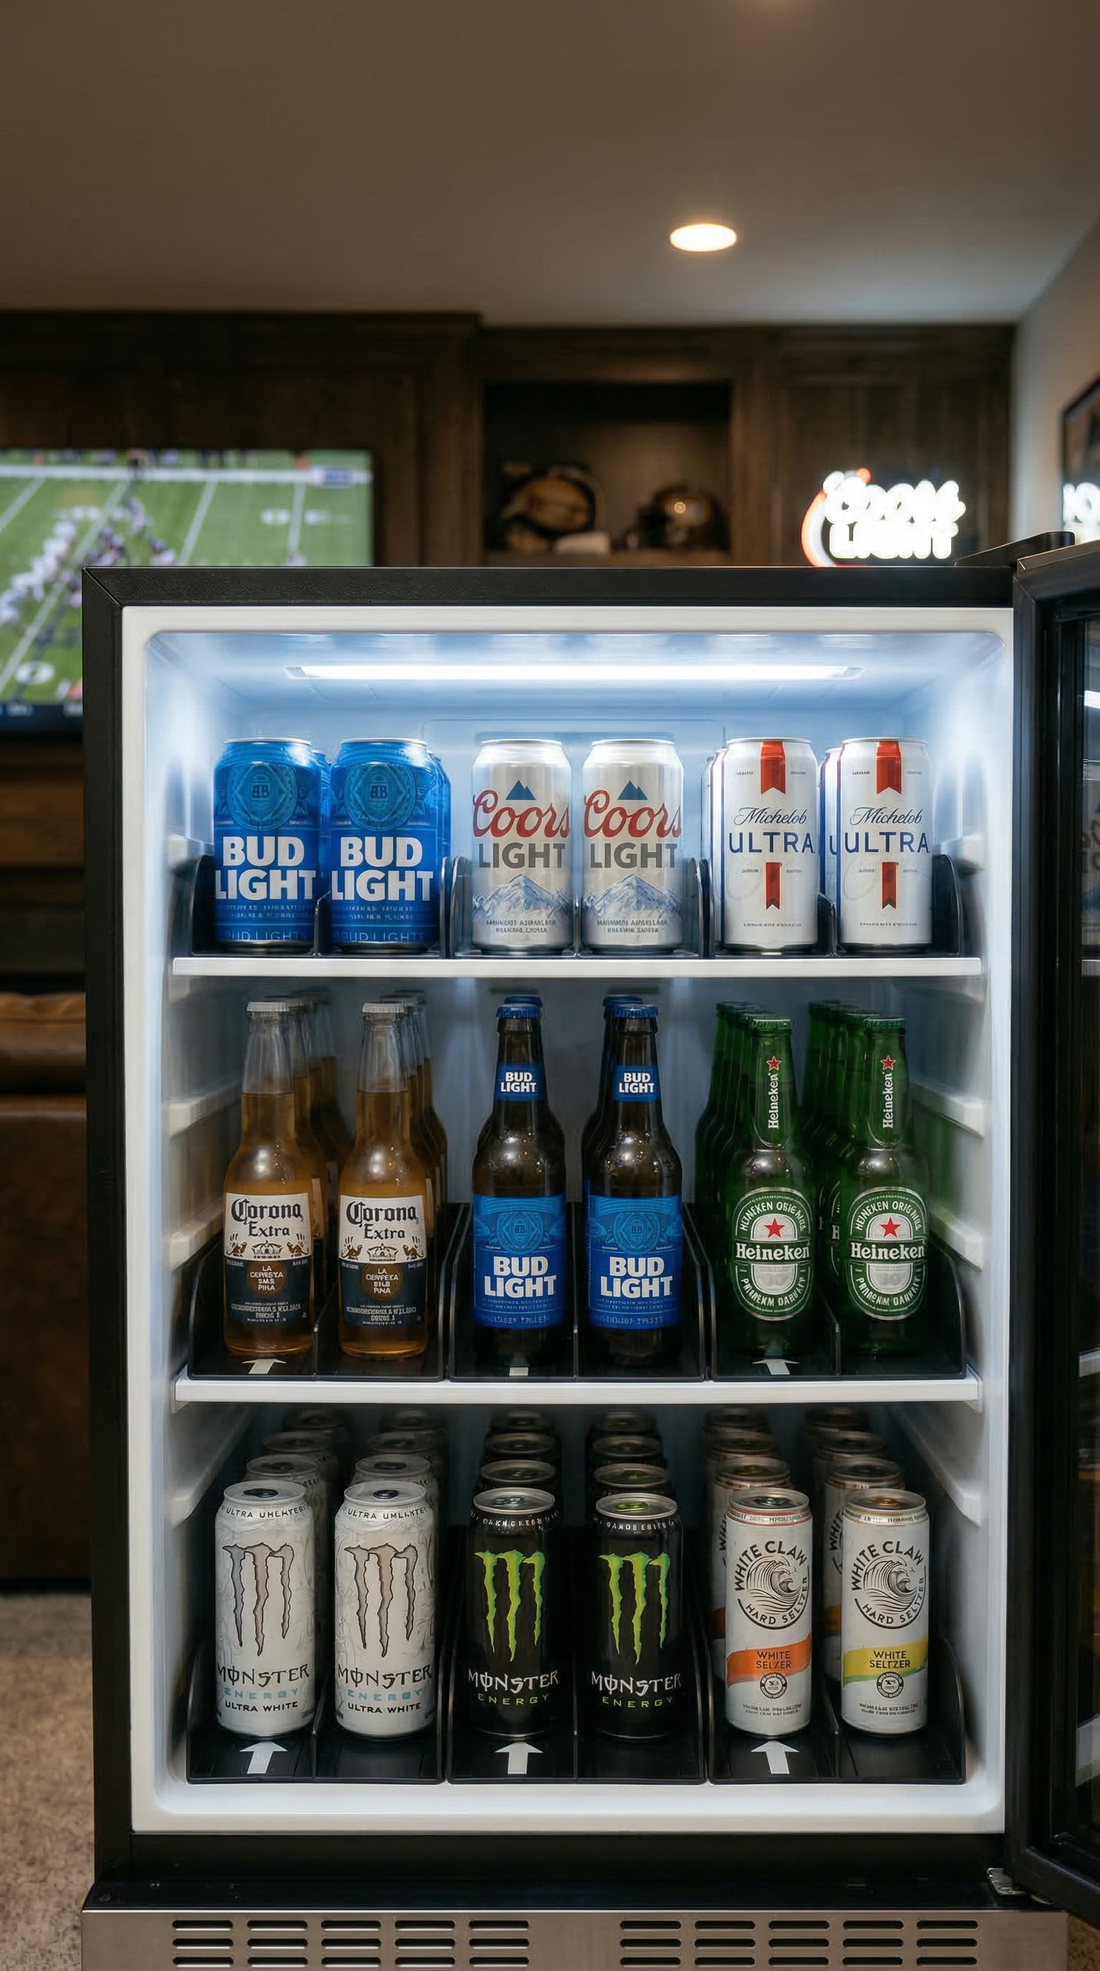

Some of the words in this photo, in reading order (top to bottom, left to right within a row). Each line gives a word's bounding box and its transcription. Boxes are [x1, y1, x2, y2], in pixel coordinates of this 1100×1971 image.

[473, 789, 570, 838] Coors
[584, 789, 682, 838] Coors
[734, 806, 808, 825] Michelob
[850, 806, 923, 825] Michelob
[223, 836, 305, 867] BUD
[340, 836, 423, 867] BUD
[729, 831, 815, 854] ULTRA
[844, 831, 930, 854] ULTRA
[479, 842, 566, 869] LIGHT
[590, 842, 677, 869] LIGHT
[215, 869, 316, 901] LIGHT
[331, 870, 434, 902] LIGHT
[505, 1071, 533, 1082] BUD
[623, 1072, 651, 1083] BUD
[501, 1082, 536, 1093] LIGHT
[619, 1082, 655, 1093] LIGHT
[768, 1072, 779, 1129] Heineken
[882, 1071, 894, 1129] Heineken
[231, 1197, 304, 1225] Corona
[346, 1200, 419, 1228] Corona
[248, 1220, 290, 1237] Extra
[363, 1223, 405, 1240] Extra
[735, 1242, 810, 1261] Heineken
[850, 1242, 925, 1260] Heineken
[493, 1256, 549, 1276] BUD
[609, 1256, 665, 1277] BUD
[484, 1275, 557, 1298] LIGHT
[600, 1275, 673, 1299] LIGHT
[226, 1507, 253, 1518] ULTRA
[347, 1507, 377, 1519] ULTRA
[734, 1543, 762, 1591] WHITE
[764, 1540, 807, 1566] CLAW
[851, 1543, 880, 1591] WHITE
[882, 1540, 924, 1566] CLAW
[745, 1603, 776, 1625] HARD
[862, 1603, 894, 1624] HARD
[756, 1650, 791, 1660] WHITE
[873, 1650, 907, 1660] WHITE
[224, 1701, 257, 1712] ULTRA
[263, 1701, 298, 1712] WHITE
[347, 1702, 382, 1714] ULTRA
[387, 1702, 422, 1713] WHITE
[477, 1693, 549, 1705] ENERGY
[602, 1695, 673, 1708] ENERGY
